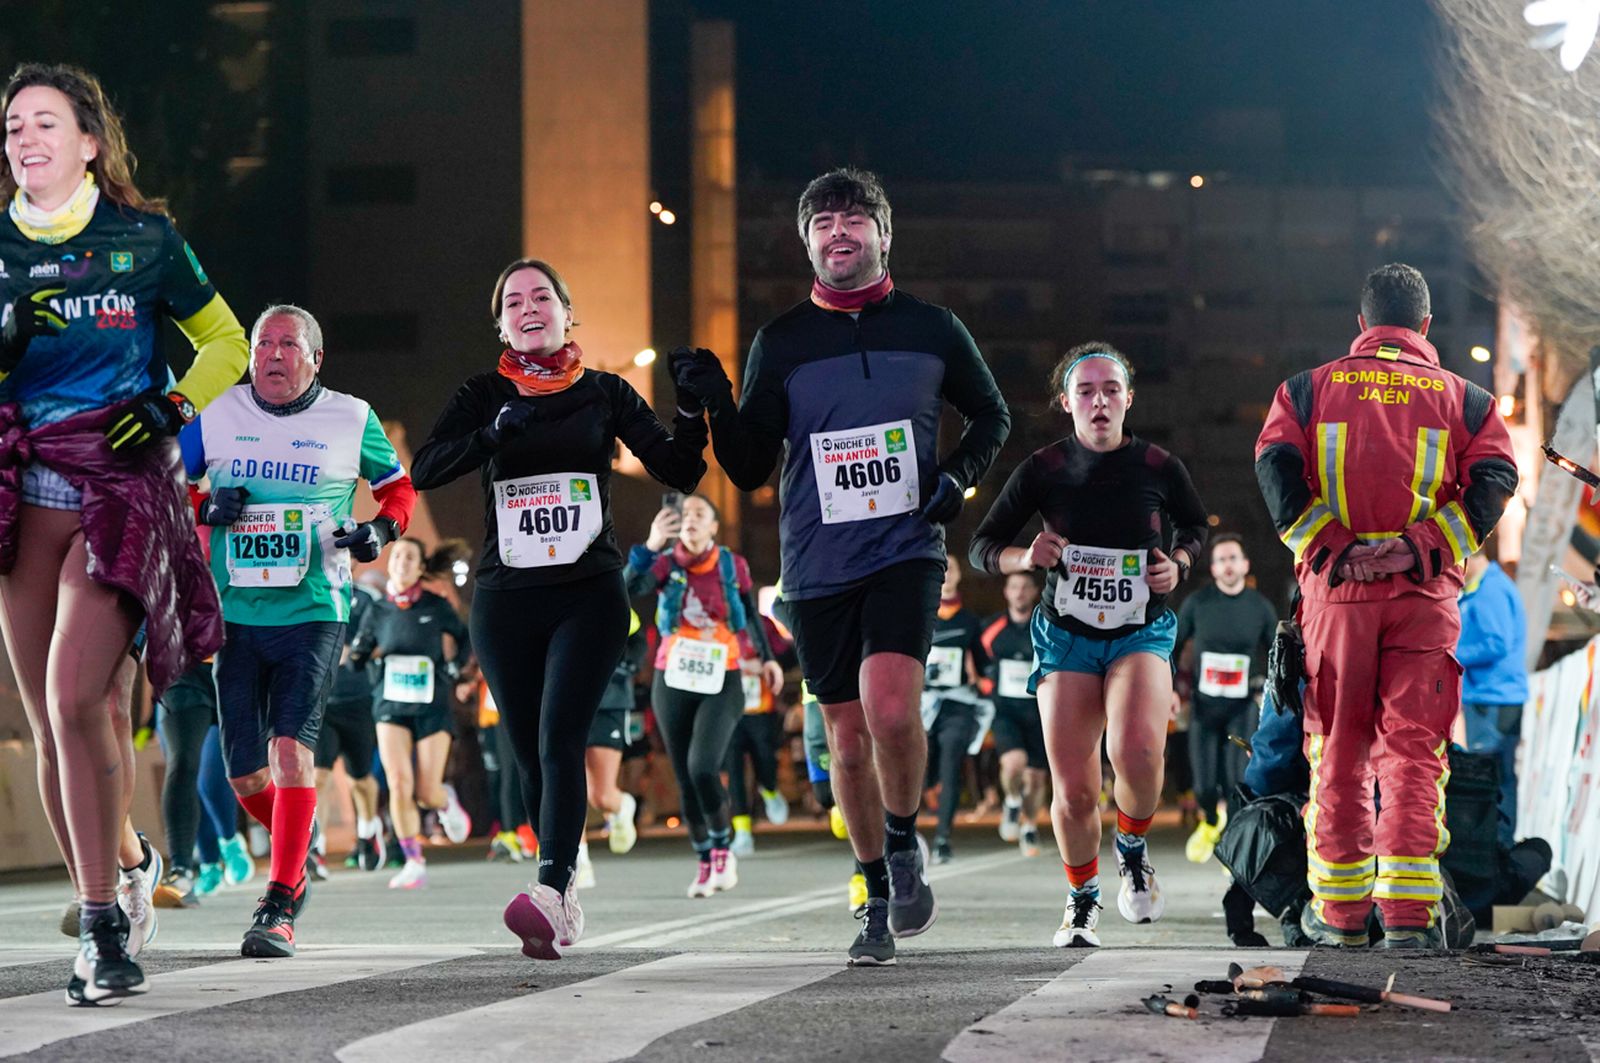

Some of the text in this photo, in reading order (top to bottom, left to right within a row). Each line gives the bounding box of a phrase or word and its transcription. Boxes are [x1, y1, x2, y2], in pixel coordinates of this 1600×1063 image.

[1331, 370, 1445, 392] BOMBEROS
[1358, 386, 1410, 405] JAÉN
[834, 439, 863, 450] NOCHE
[865, 437, 876, 446] DE
[825, 453, 844, 464] SAN
[231, 459, 320, 485] C.D GILETE
[835, 456, 901, 490] 4606
[518, 486, 548, 496] NOCHE
[549, 484, 561, 493] DE
[507, 498, 527, 509] SAN
[265, 513, 276, 522] DE
[518, 505, 581, 535] 4607
[232, 524, 245, 534] SAN
[232, 533, 300, 559] 12639
[1081, 556, 1105, 566] NOCHE
[1070, 564, 1087, 574] SAN
[1072, 576, 1133, 603] 4556
[679, 658, 714, 675] 5853
